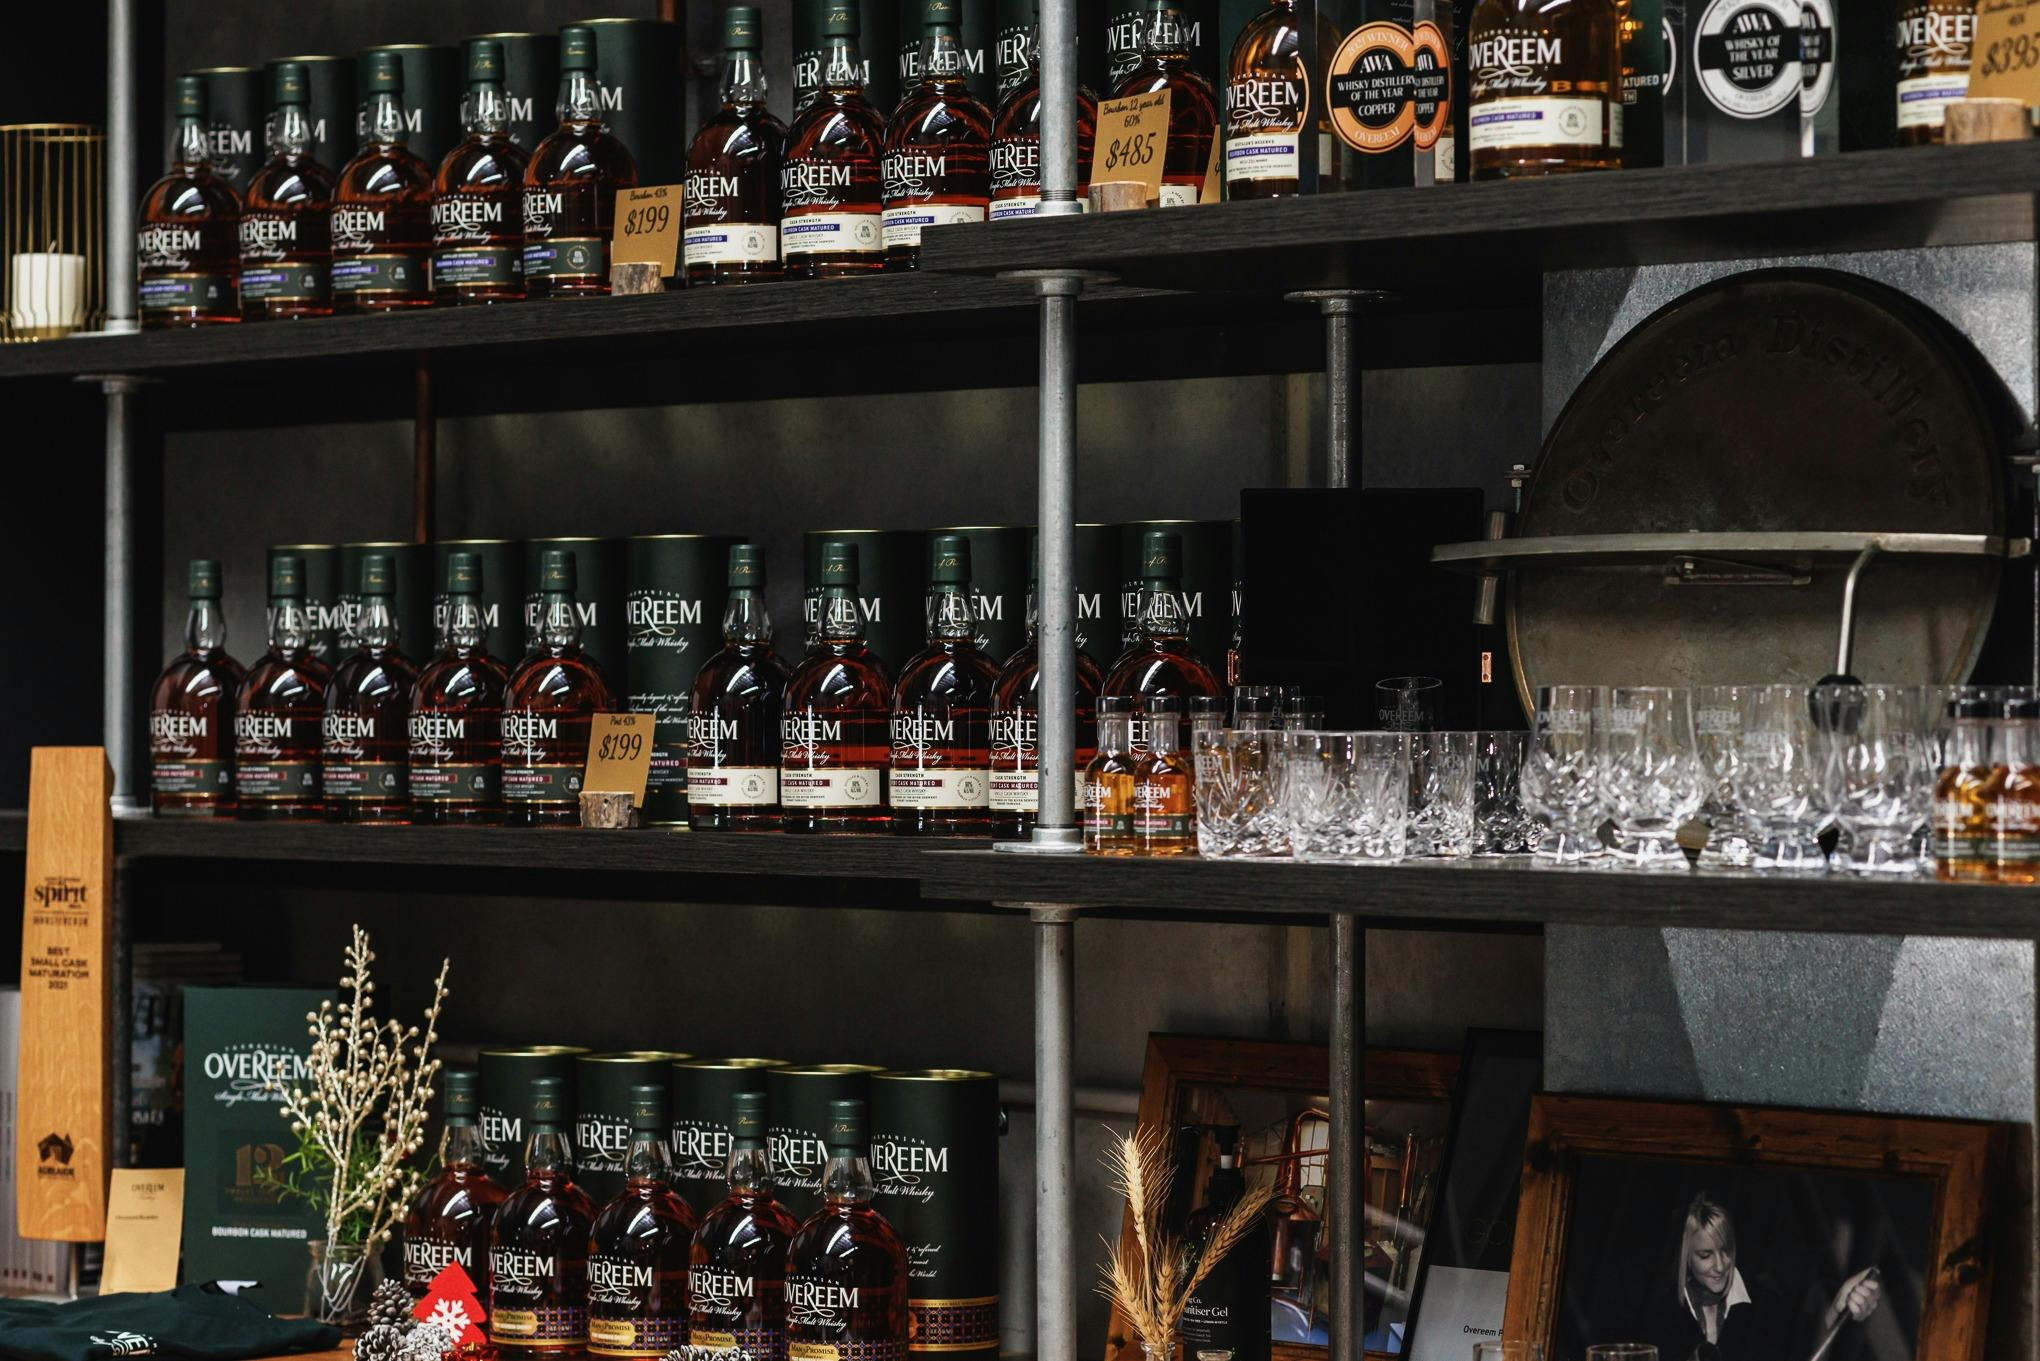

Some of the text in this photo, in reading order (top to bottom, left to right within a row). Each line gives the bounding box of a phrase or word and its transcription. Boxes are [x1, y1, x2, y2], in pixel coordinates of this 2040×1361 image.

[1733, 13, 1772, 33] AWA
[1897, 12, 1977, 47] VEREE
[1725, 37, 1765, 50] WHISKY
[1730, 48, 1778, 62] THE YEAR
[1360, 55, 1393, 74] AWA
[1733, 64, 1774, 80] SILVER
[1337, 74, 1416, 91] WHISKY DISTILLERY
[1350, 88, 1403, 101] OF THE YEAR
[1358, 103, 1395, 116] COPPER
[1260, 117, 1295, 133] Whisky
[989, 143, 1041, 169] VEREE
[1106, 132, 1157, 172] $485
[881, 155, 946, 180] VEREEM
[1019, 177, 1041, 192] Whisk
[906, 187, 934, 202] Whisky
[811, 196, 840, 210] Whisky
[625, 205, 670, 237] $199
[703, 207, 728, 221] Whisky
[626, 597, 702, 626] VEREEM
[656, 637, 689, 653] Whisky
[780, 716, 841, 741] VEREEM
[890, 716, 954, 741] VEREEM
[988, 716, 1037, 741] VEREE
[599, 733, 642, 761] $199
[33, 886, 87, 908] spirit
[47, 947, 70, 955] BEST
[31, 957, 88, 967] SMALL CASK
[29, 968, 89, 978] MATURATION
[204, 1050, 314, 1080] OVEREEM
[871, 1142, 949, 1172] VEREEM
[880, 1184, 935, 1204] Malt Whisky
[212, 1226, 308, 1239] BOURBON CASK MATURED
[614, 1296, 642, 1310] Whisky
[714, 1305, 742, 1321] Whisky
[1211, 1307, 1228, 1316] Gel
[798, 1316, 847, 1333] Malt Whisky
[1463, 1325, 1496, 1337] Overeem
